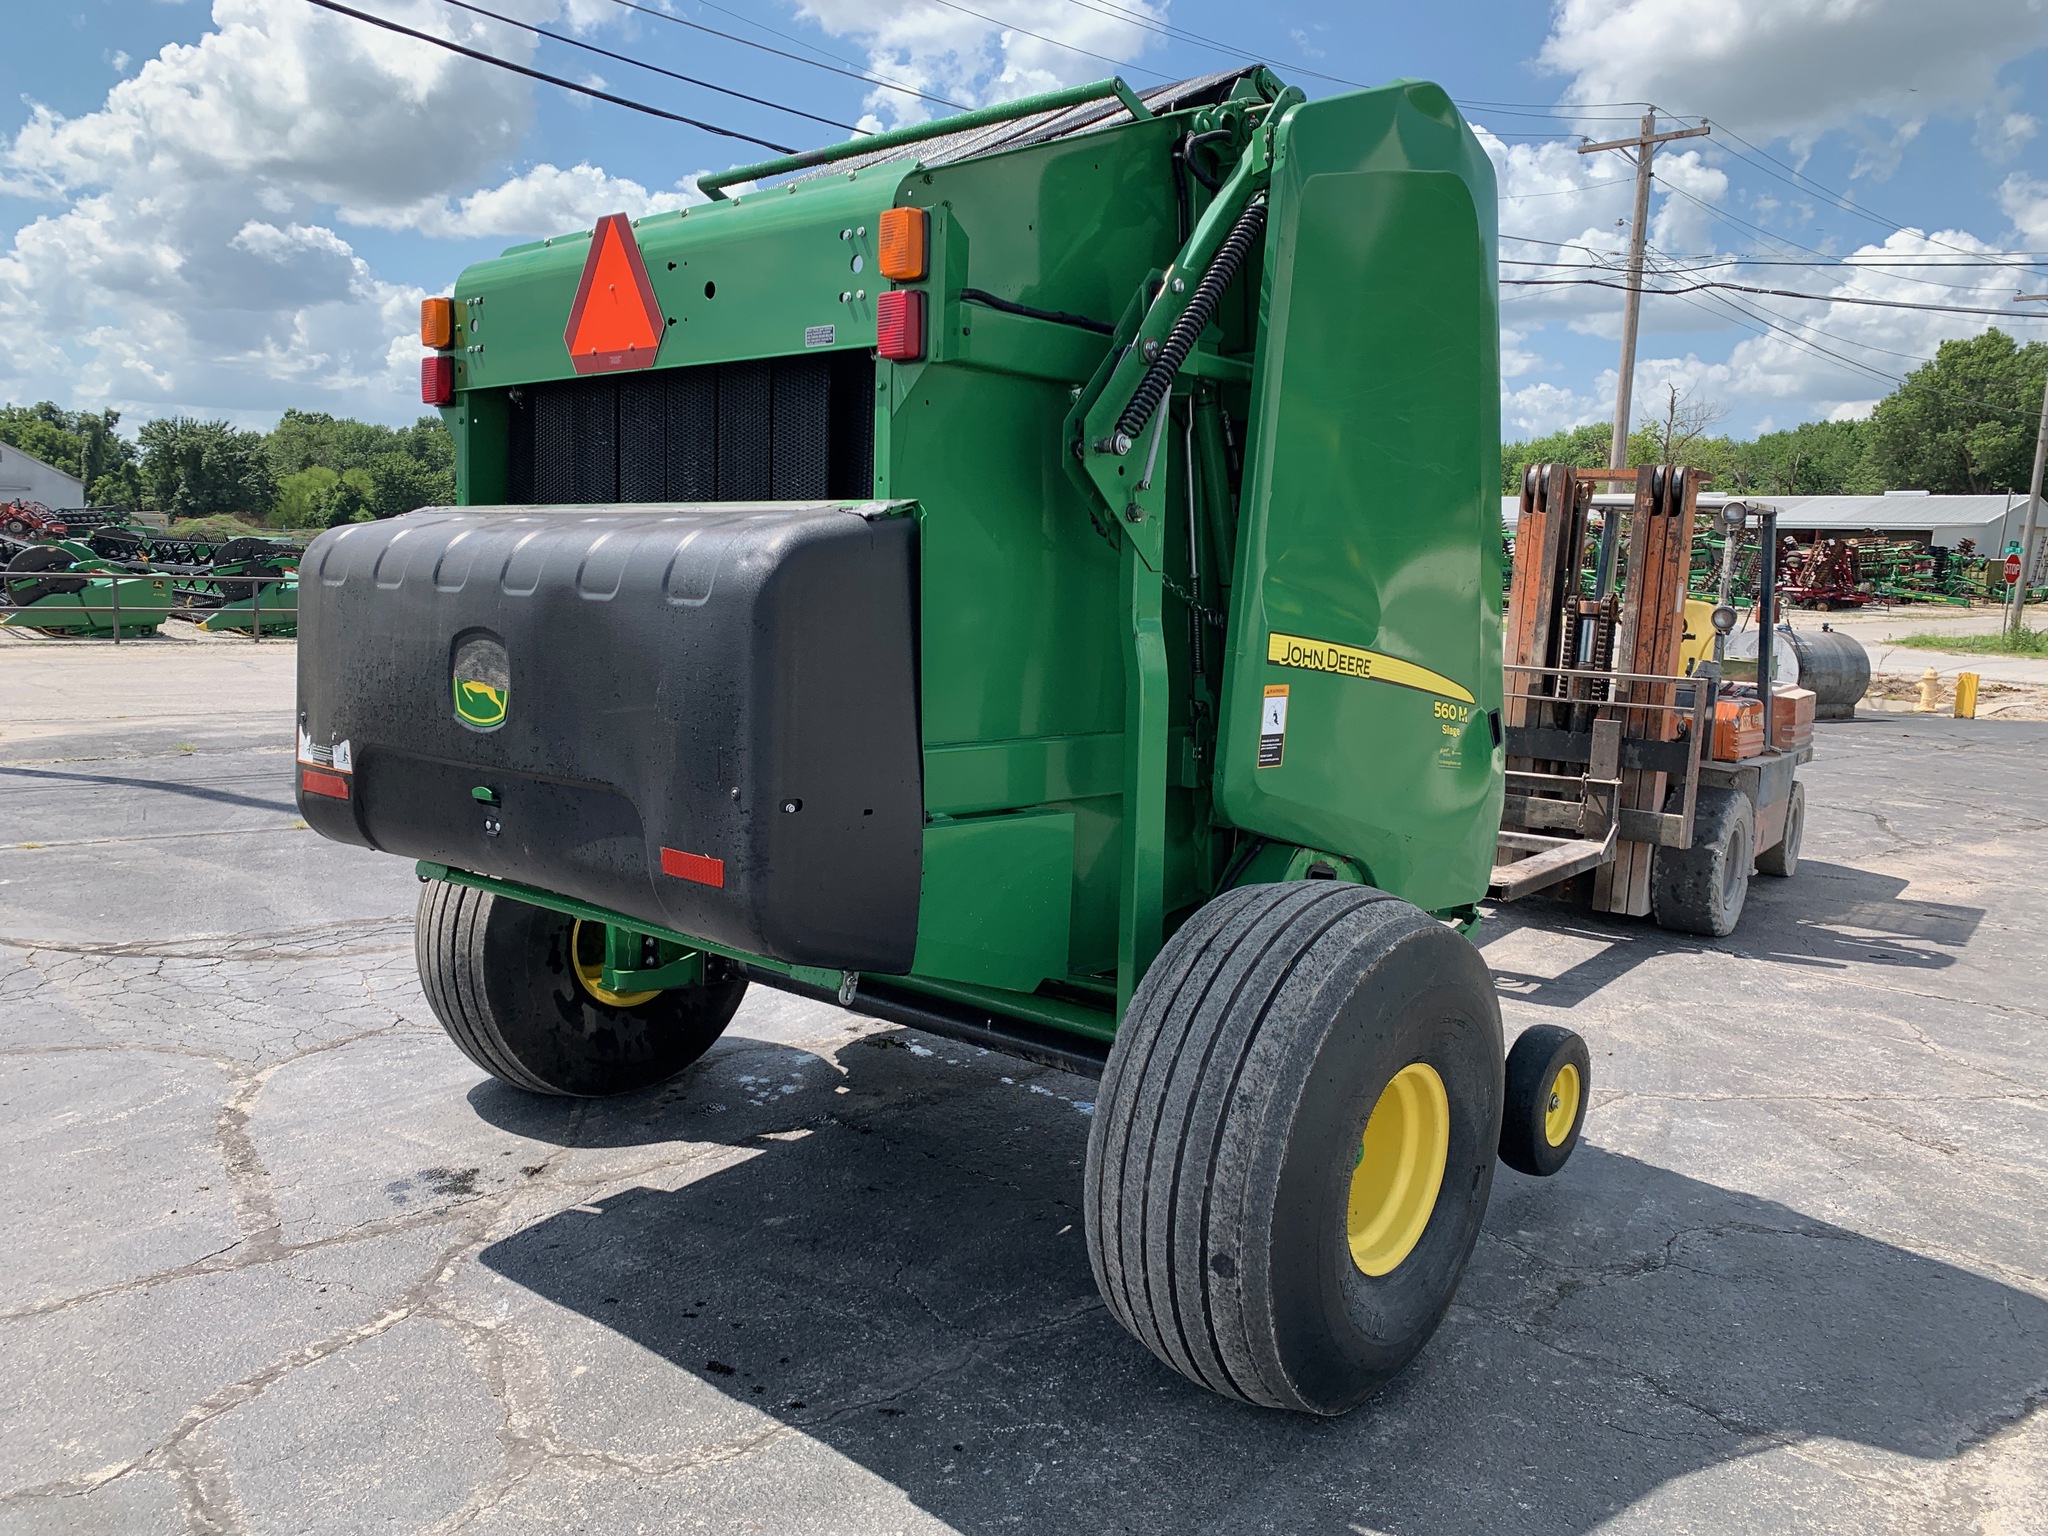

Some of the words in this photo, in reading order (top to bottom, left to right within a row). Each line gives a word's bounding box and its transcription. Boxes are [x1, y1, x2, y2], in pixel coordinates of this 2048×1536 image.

[2005, 563, 2020, 575] STOP
[1281, 642, 1324, 667] JOHN
[1327, 648, 1371, 675] DEERE
[1434, 701, 1457, 721] 560
[1458, 705, 1468, 724] M
[1441, 724, 1461, 738] Silage
